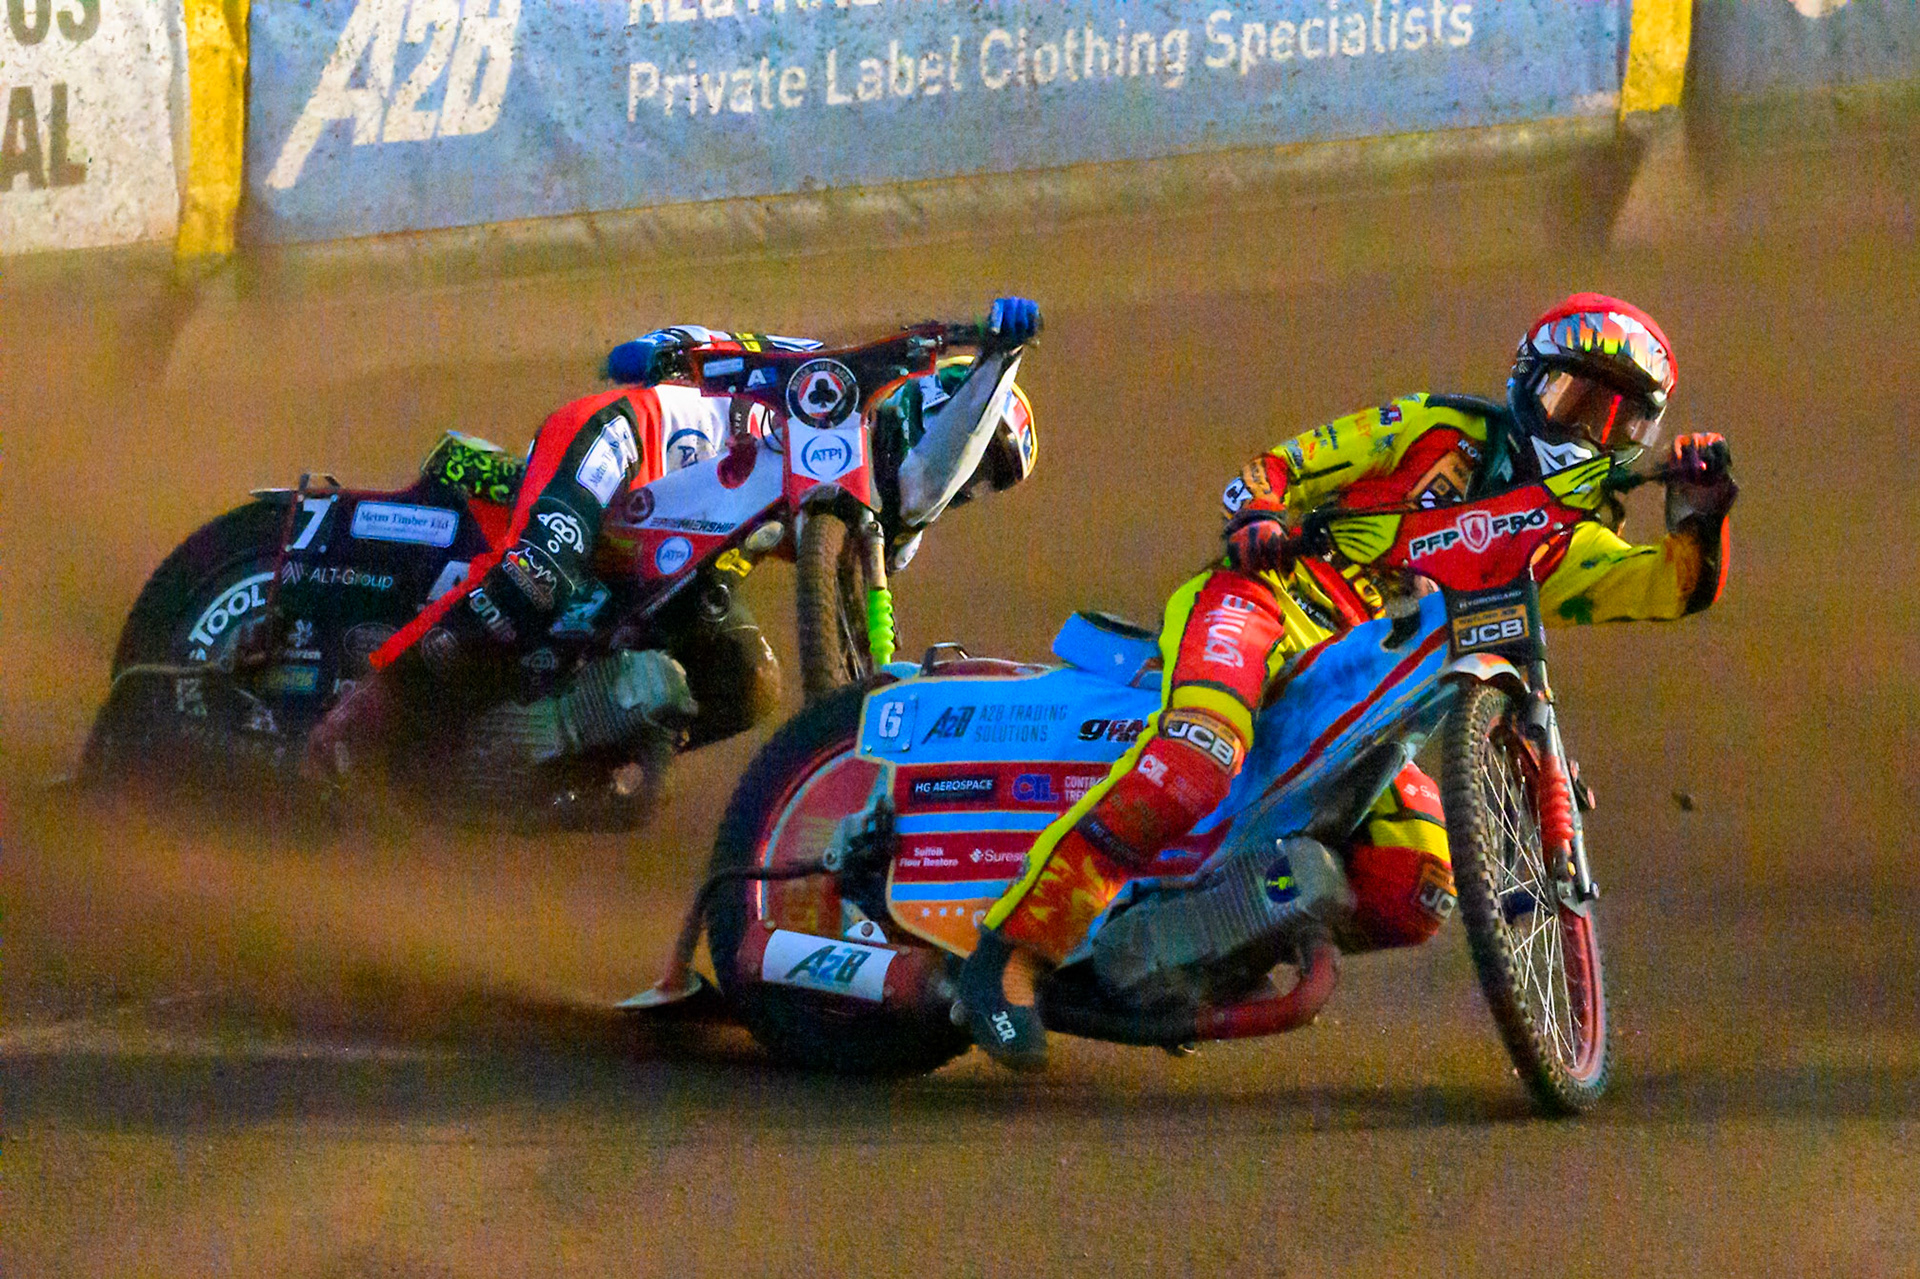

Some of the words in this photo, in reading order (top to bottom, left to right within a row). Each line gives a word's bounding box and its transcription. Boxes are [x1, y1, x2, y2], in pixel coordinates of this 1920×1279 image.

[628, 56, 807, 122] Private
[826, 35, 963, 105] Label
[979, 19, 1189, 89] Clothing
[1203, 0, 1475, 74] Specialists
[293, 499, 332, 549] 7
[392, 513, 427, 526] Timber
[1411, 528, 1460, 557] PFP
[1492, 508, 1547, 534] PRO
[197, 584, 266, 646] TOOL
[1460, 618, 1524, 647] JCB
[878, 701, 904, 739] 6
[1009, 704, 1068, 722] TRADING
[975, 724, 1050, 743] SOLUTIONS
[1167, 722, 1236, 765] JCB
[915, 782, 931, 793] HG
[932, 779, 993, 792] AEROSPACE
[914, 847, 944, 857] Suffolk
[785, 944, 872, 983] A2B
